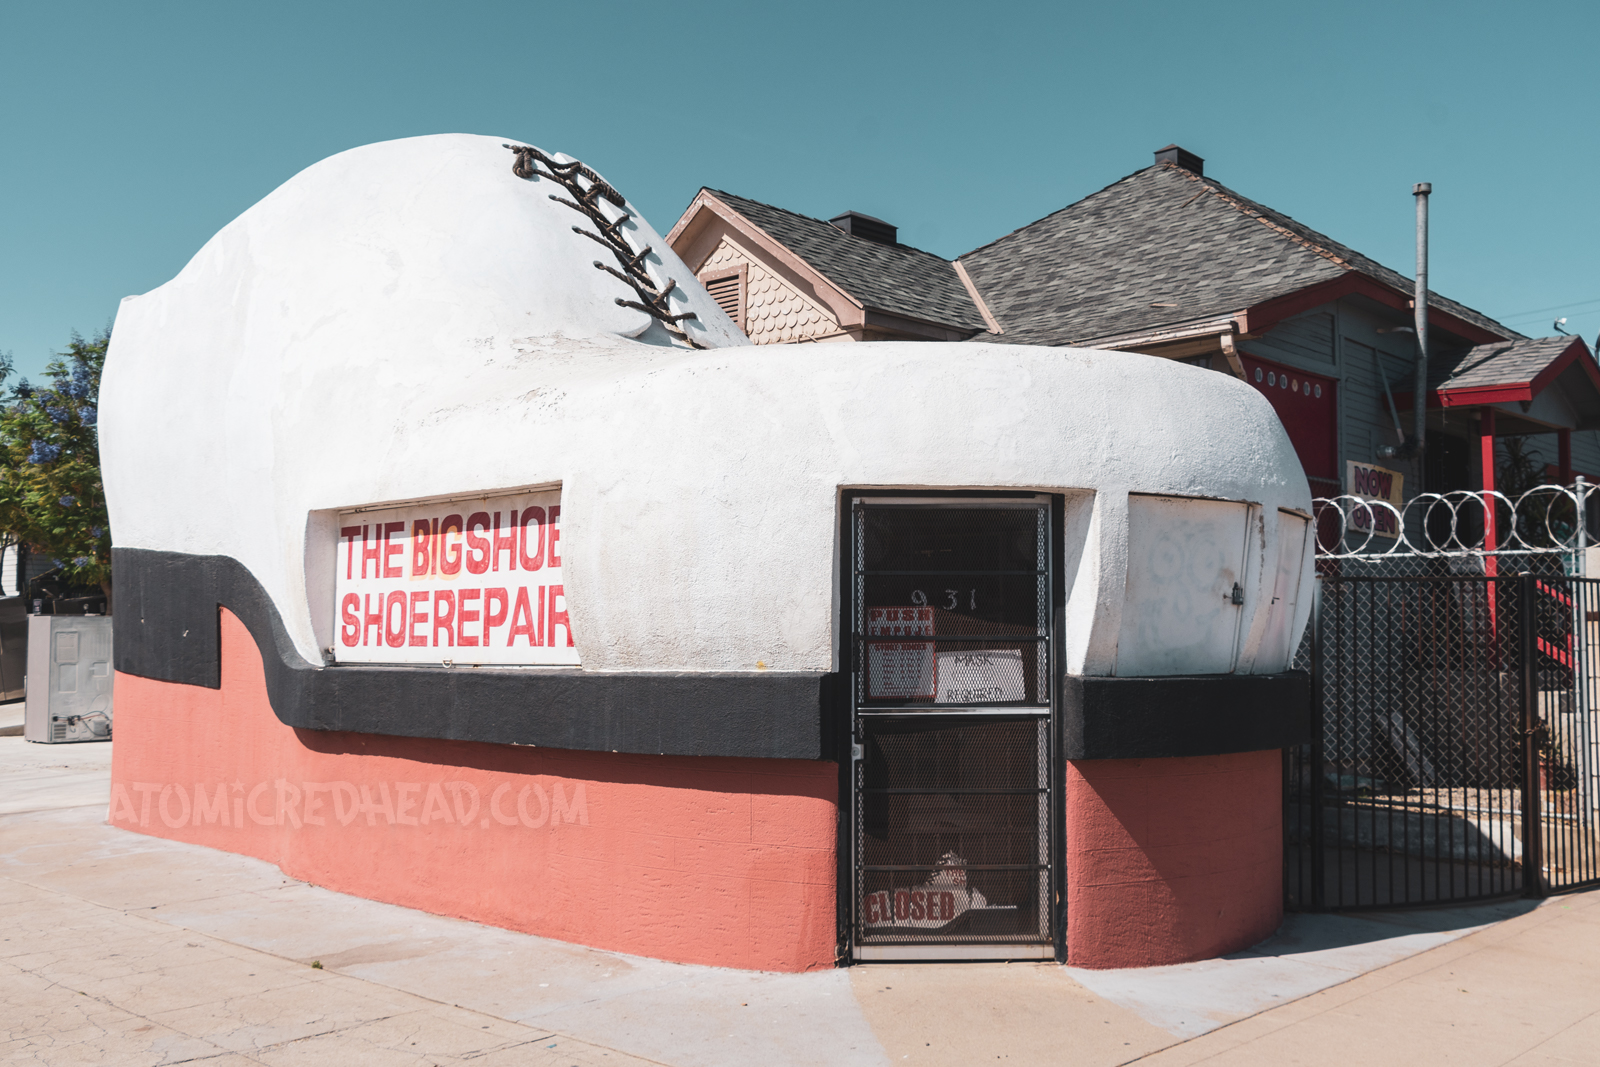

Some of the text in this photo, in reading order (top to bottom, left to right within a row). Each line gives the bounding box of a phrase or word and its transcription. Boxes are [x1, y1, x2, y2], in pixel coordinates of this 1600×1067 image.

[1354, 465, 1393, 500] NOW
[1352, 502, 1396, 534] OPEN
[341, 521, 405, 580] THE
[870, 609, 931, 622] PUSH
[870, 625, 932, 636] EMPUJE
[864, 891, 955, 924] CLOSED
